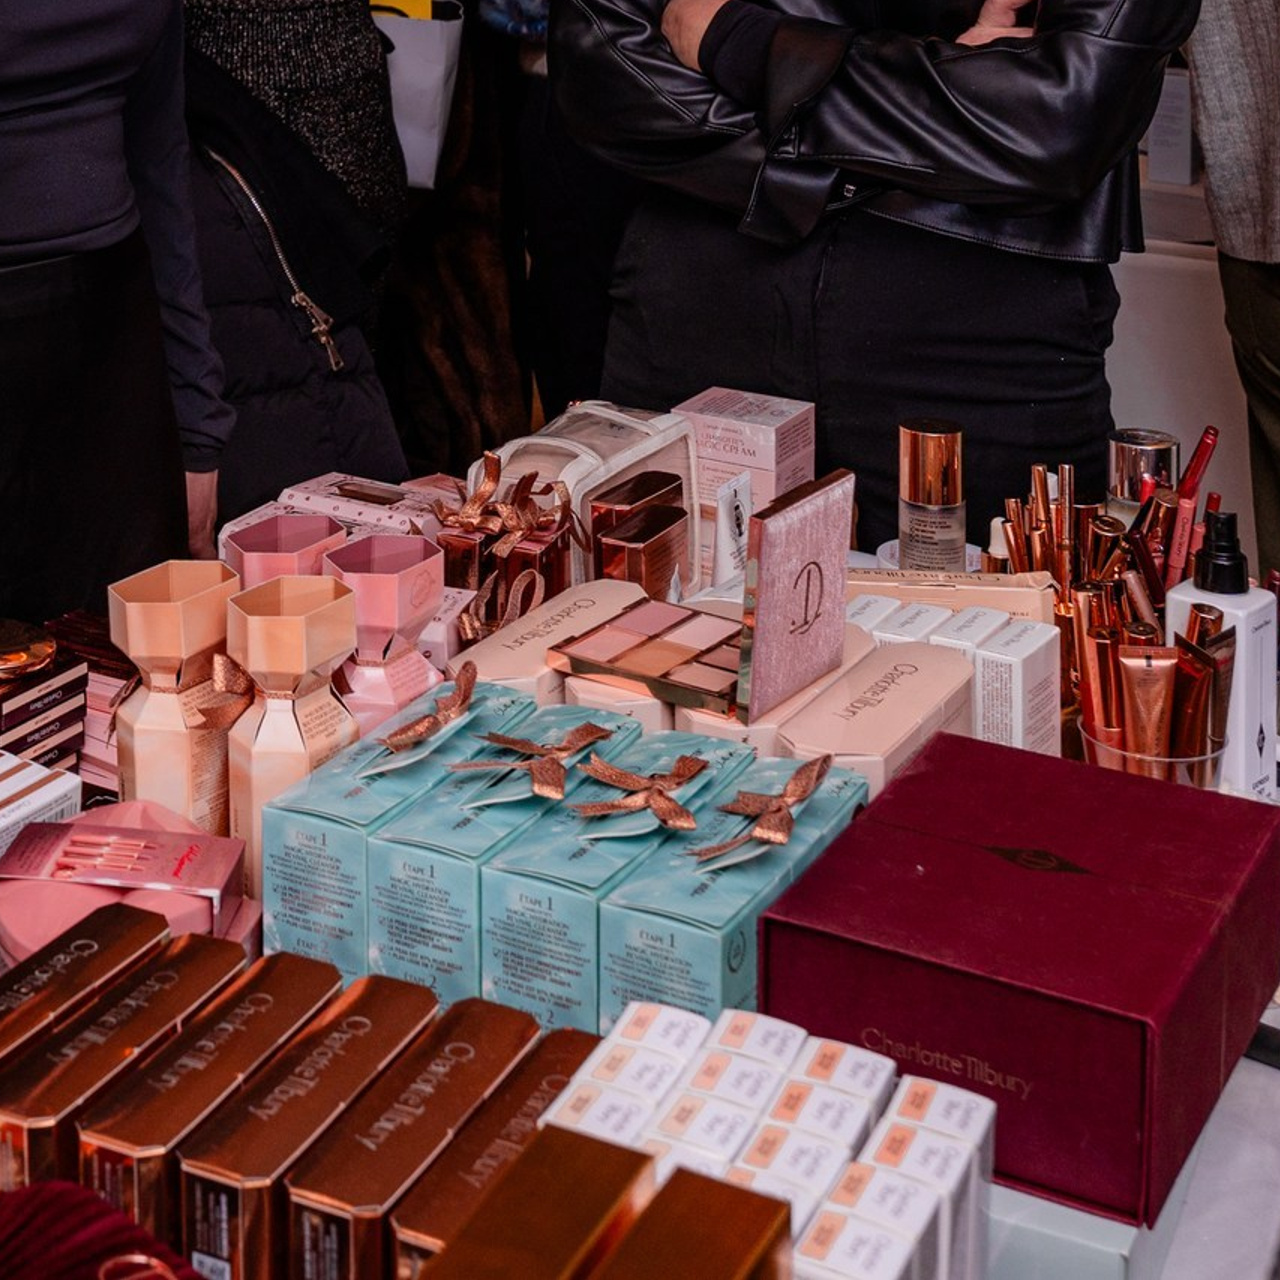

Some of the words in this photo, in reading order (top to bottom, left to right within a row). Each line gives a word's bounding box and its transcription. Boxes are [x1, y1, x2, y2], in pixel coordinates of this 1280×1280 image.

[723, 442, 757, 458] CREAM
[544, 598, 596, 630] Charlotte
[501, 624, 555, 652] Tilbury
[866, 662, 919, 696] Charlotte
[833, 693, 883, 721] Tilbury
[320, 832, 328, 847] 1
[403, 861, 425, 875] ÉTAPE
[428, 864, 435, 878] 1
[390, 883, 415, 896] REVIVAL
[416, 889, 449, 904] CLEANSER
[412, 880, 451, 897] HYDRATION
[519, 893, 543, 908] ÉTAPE
[547, 896, 554, 911] 1
[529, 914, 570, 931] HYDRATION
[533, 921, 568, 937] CLEANSER
[639, 929, 664, 945] ÉTAPE
[669, 933, 676, 949] 1
[13, 939, 99, 993] Charlotte
[649, 950, 693, 968] HYDRATION
[654, 959, 692, 976] CLEANSER
[429, 975, 437, 989] 2
[98, 970, 179, 1025] Charlotte
[196, 993, 274, 1051] Charlotte
[546, 1010, 555, 1025] 2
[45, 1022, 112, 1063] Tilbury
[295, 1016, 372, 1078] Charlotte
[147, 1048, 218, 1093] Tilbury
[400, 1041, 476, 1106] Charlotte
[860, 1027, 963, 1076] Charlotte
[960, 1054, 1035, 1102] Tilbury
[248, 1074, 320, 1122] Tilbury
[354, 1101, 424, 1152] Tilbury
